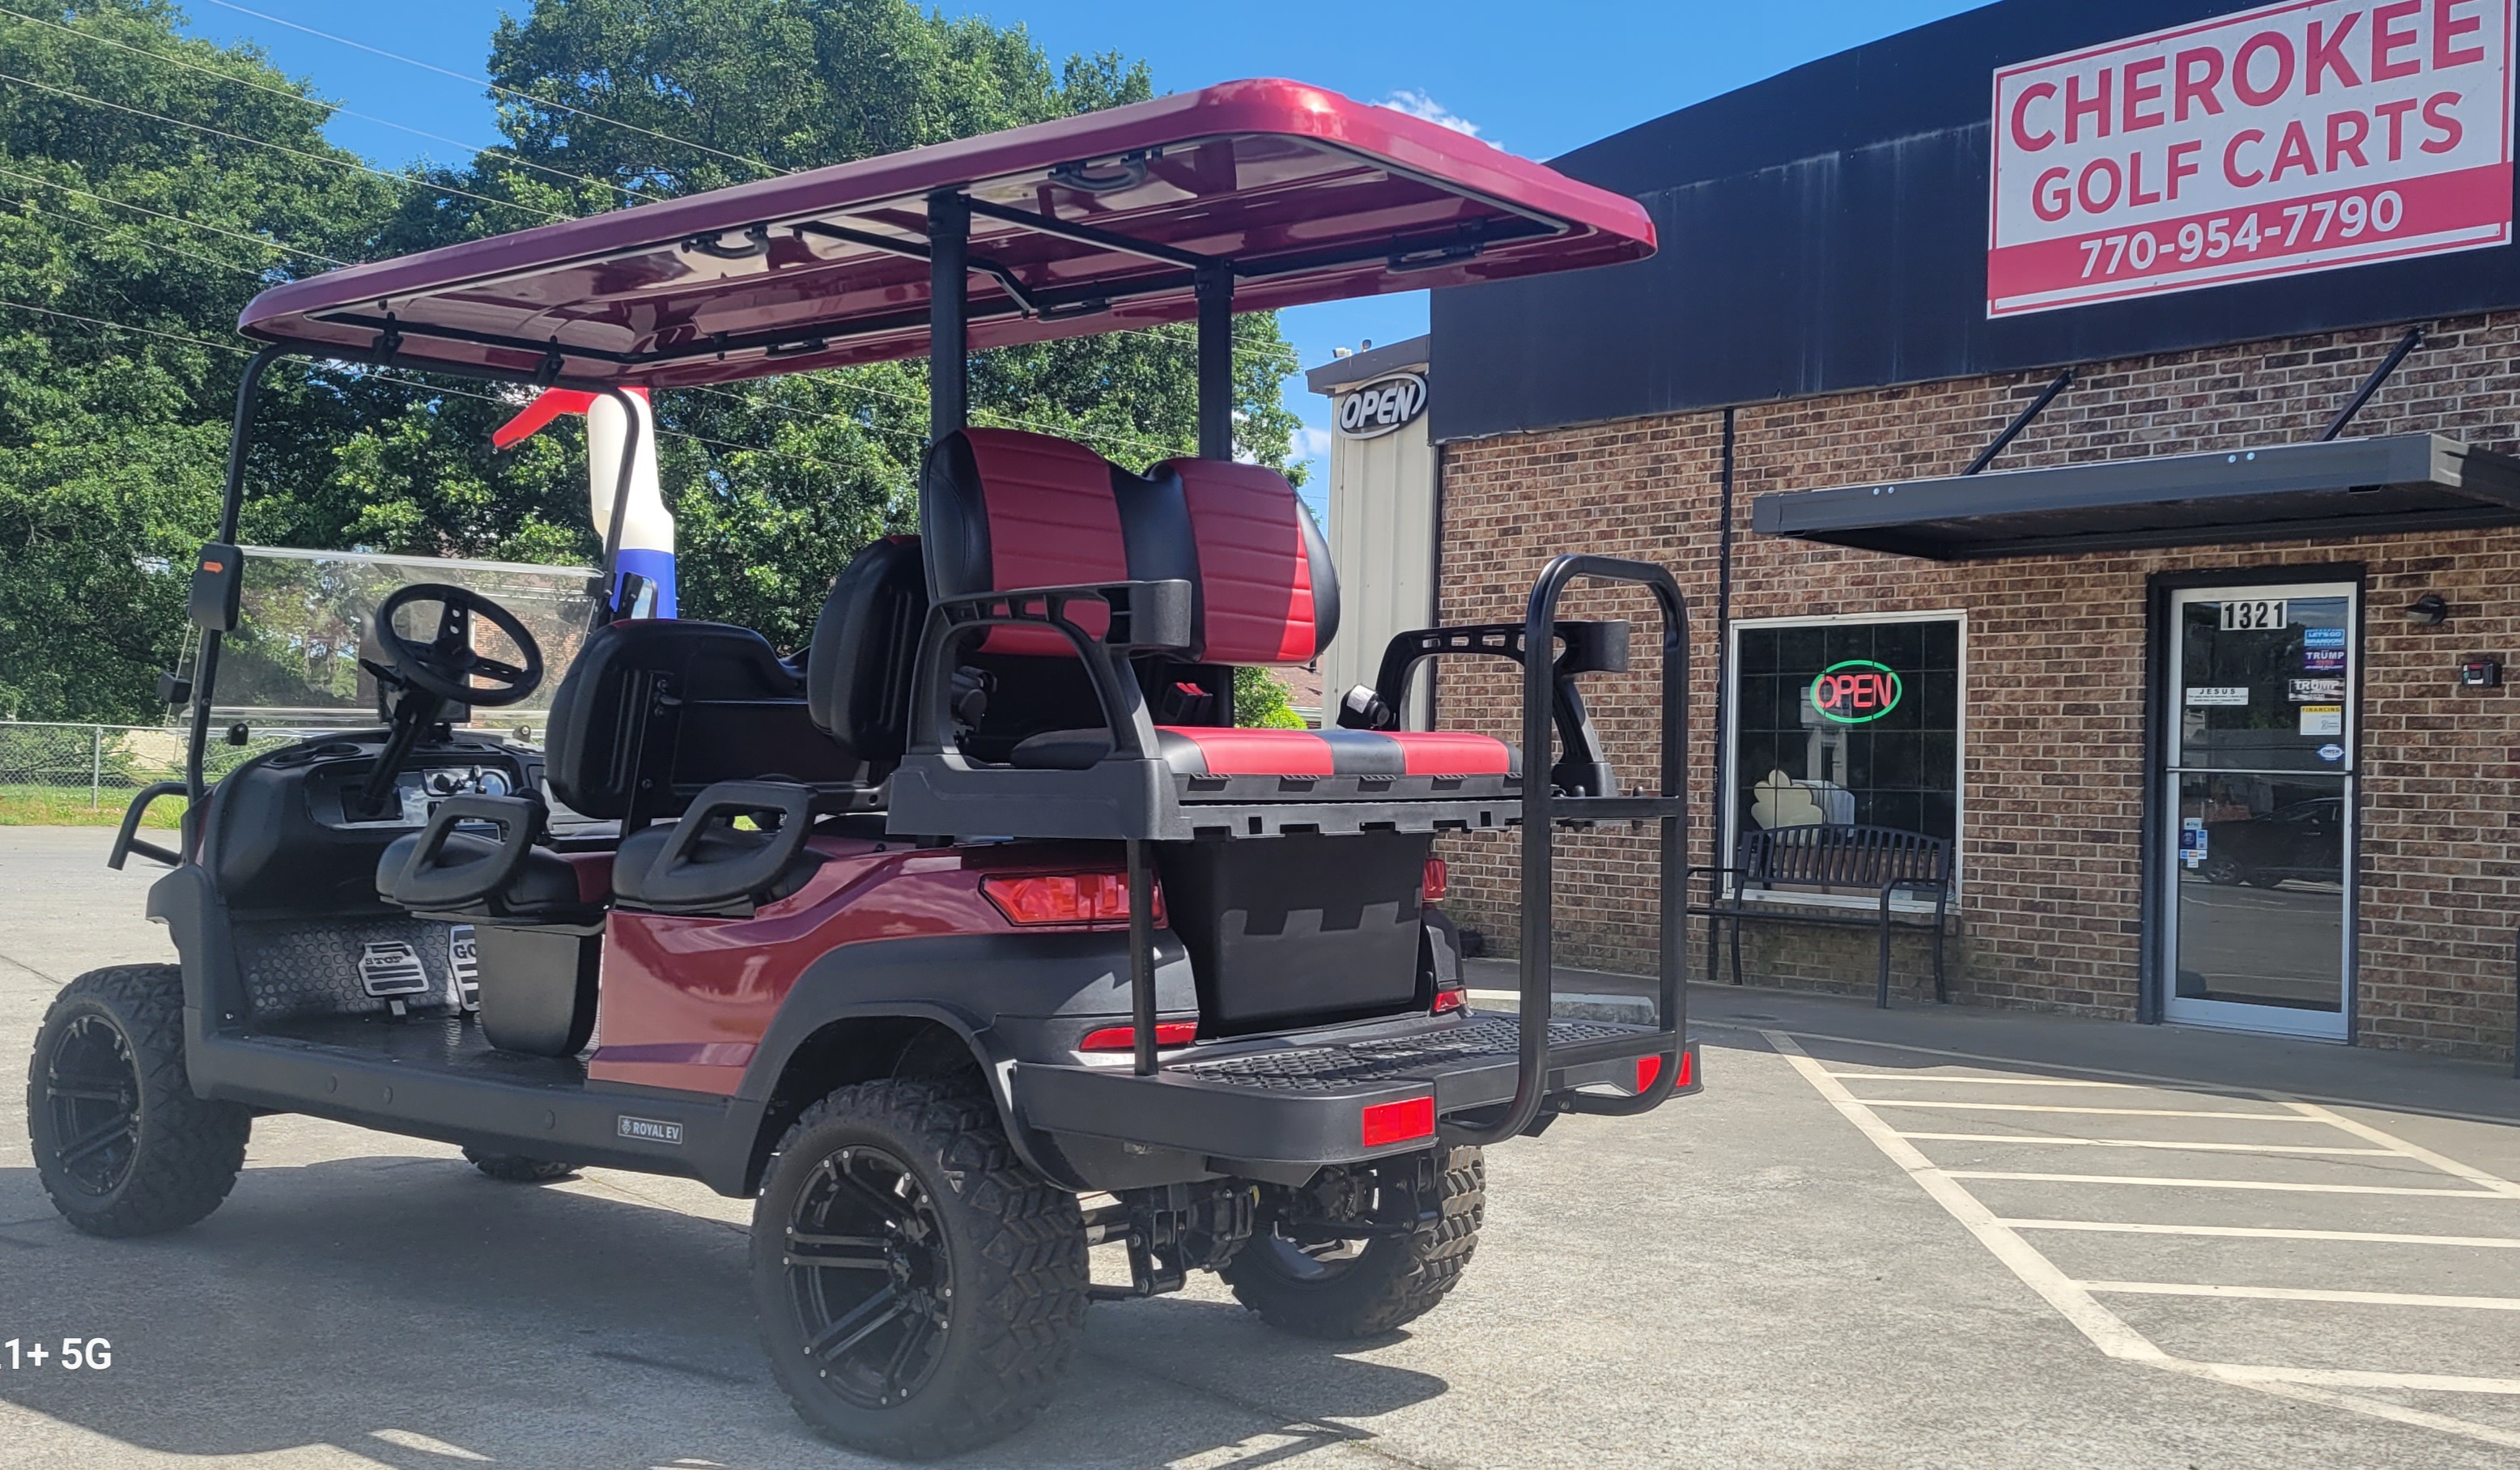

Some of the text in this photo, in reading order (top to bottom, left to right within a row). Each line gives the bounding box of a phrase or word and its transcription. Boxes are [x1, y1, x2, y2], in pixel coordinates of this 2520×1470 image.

[2011, 0, 2484, 152] CHEROKEE
[2032, 91, 2463, 223] GOLF CARTS
[2080, 190, 2403, 278] 770-954-7790
[1341, 384, 1417, 429] OPEN
[2225, 601, 2284, 629] 1321
[2305, 651, 2345, 661] TRUMP
[1816, 673, 1892, 709] OPEN
[2293, 679, 2340, 690] TRUMP
[365, 956, 403, 965] STOP
[453, 943, 477, 959] GO
[633, 1122, 679, 1140] ROYAL EV
